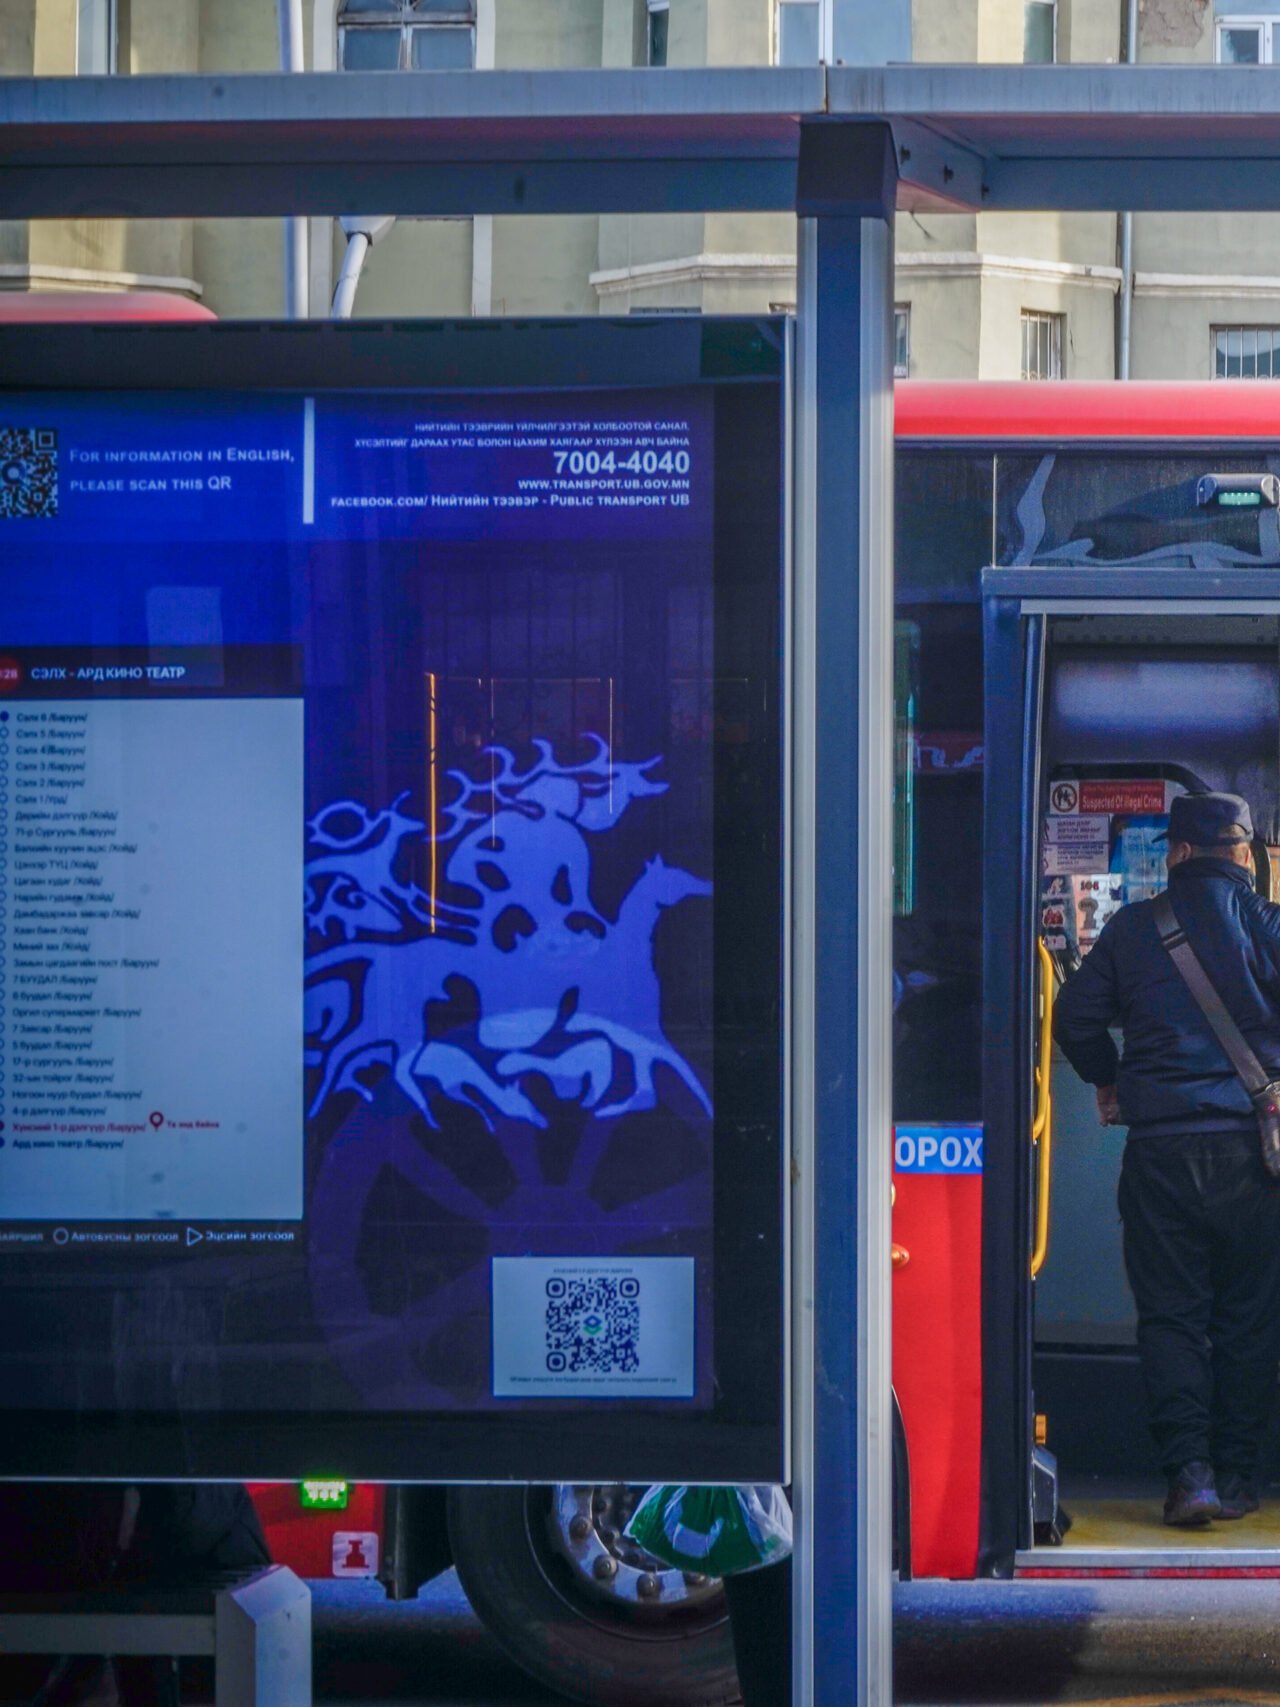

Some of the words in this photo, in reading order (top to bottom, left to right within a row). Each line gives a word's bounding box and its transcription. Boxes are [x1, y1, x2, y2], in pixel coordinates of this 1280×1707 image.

[415, 421, 460, 432] НИЙТИЙН
[593, 421, 652, 432] ХОЛБООТОЙ
[410, 437, 449, 448] ДАРААХ
[451, 437, 475, 448] УТАС
[478, 437, 511, 448] БОЛОН
[513, 437, 547, 448] ЦАХИМ
[550, 437, 593, 448] ХАЯГААР
[595, 437, 632, 448] ХҮЛЭЭН
[635, 437, 654, 448] АВЧ
[656, 437, 690, 448] БАЙНА
[552, 450, 690, 475] 7004-4040
[207, 475, 232, 491] QR
[670, 493, 690, 506] UB
[31, 667, 66, 679] СЭЛХ
[77, 667, 104, 681] АРД
[106, 667, 142, 679] КИНО
[145, 667, 186, 679] ТЕАТР
[1082, 794, 1114, 812] Suspected
[1115, 795, 1123, 809] Of
[1144, 794, 1162, 809] Crime
[13, 1139, 31, 1150] Ард
[895, 1136, 983, 1167] ОРОХ
